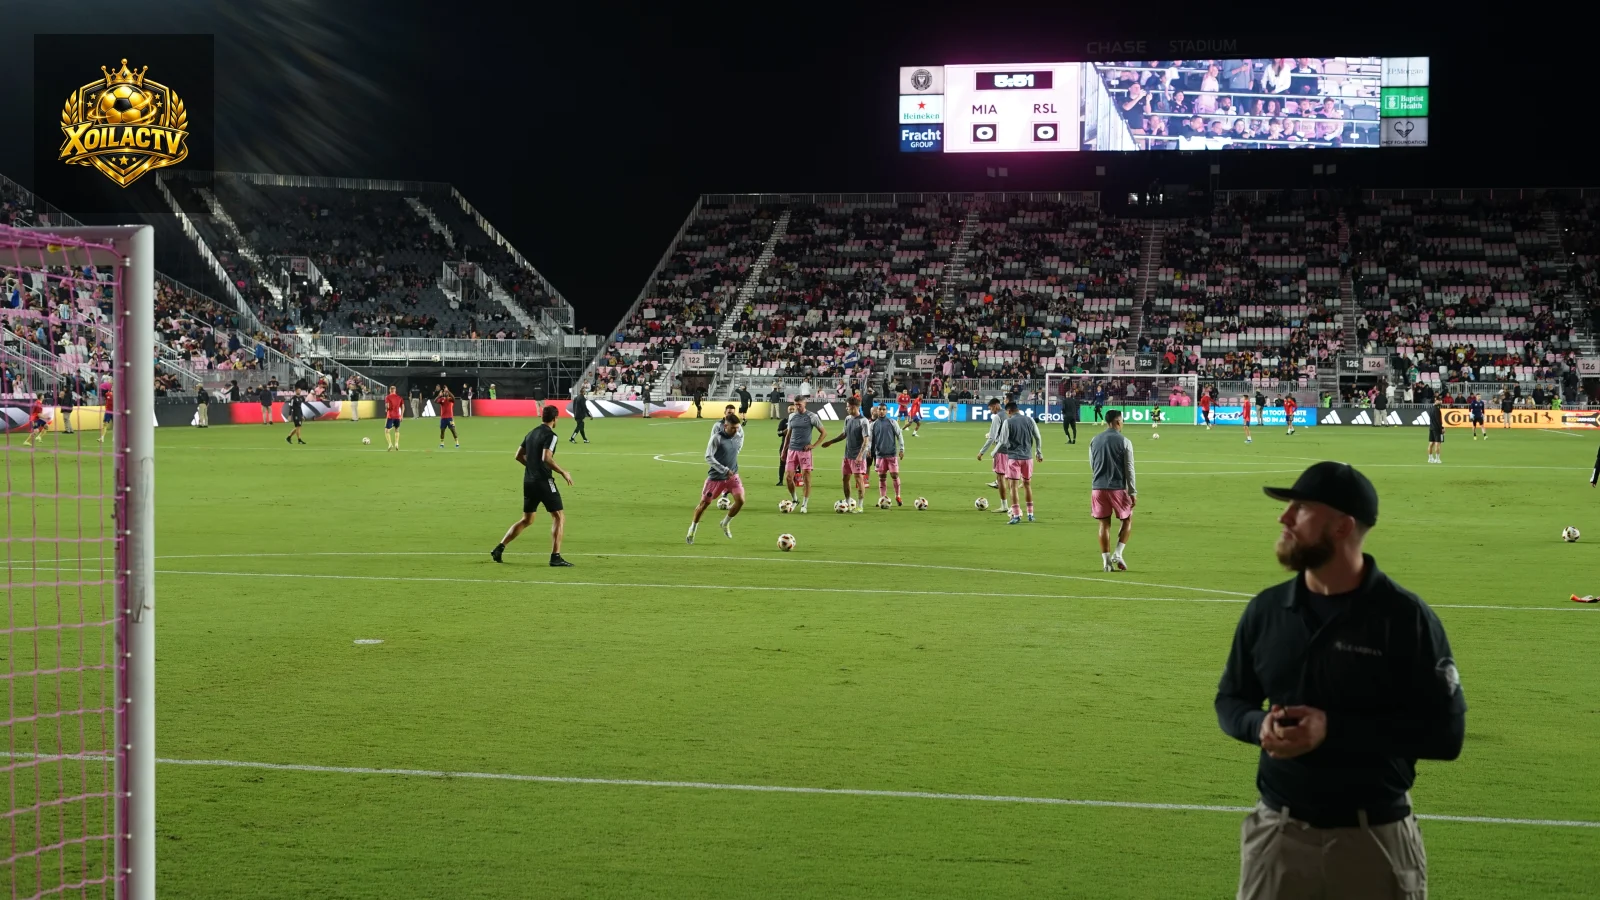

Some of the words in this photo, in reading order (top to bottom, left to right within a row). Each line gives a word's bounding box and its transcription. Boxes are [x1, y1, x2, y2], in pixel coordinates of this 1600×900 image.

[1086, 41, 1147, 55] CHASE
[1169, 39, 1237, 53] STADIUM
[1401, 95, 1424, 103] Baptist
[972, 104, 998, 115] MIA
[1033, 103, 1057, 114] RSL
[1401, 102, 1423, 110] Health
[903, 112, 940, 120] Heineken
[902, 129, 941, 140] Fracht
[708, 356, 720, 364] 123
[899, 358, 912, 366] 123
[1118, 359, 1131, 367] 124
[1139, 359, 1152, 367] 125
[1345, 360, 1359, 368] 125
[1368, 360, 1381, 368] 126
[1581, 362, 1596, 370] 126
[971, 406, 1034, 420] Frt
[1038, 413, 1064, 421] GRO
[1444, 410, 1538, 426] Connetal
